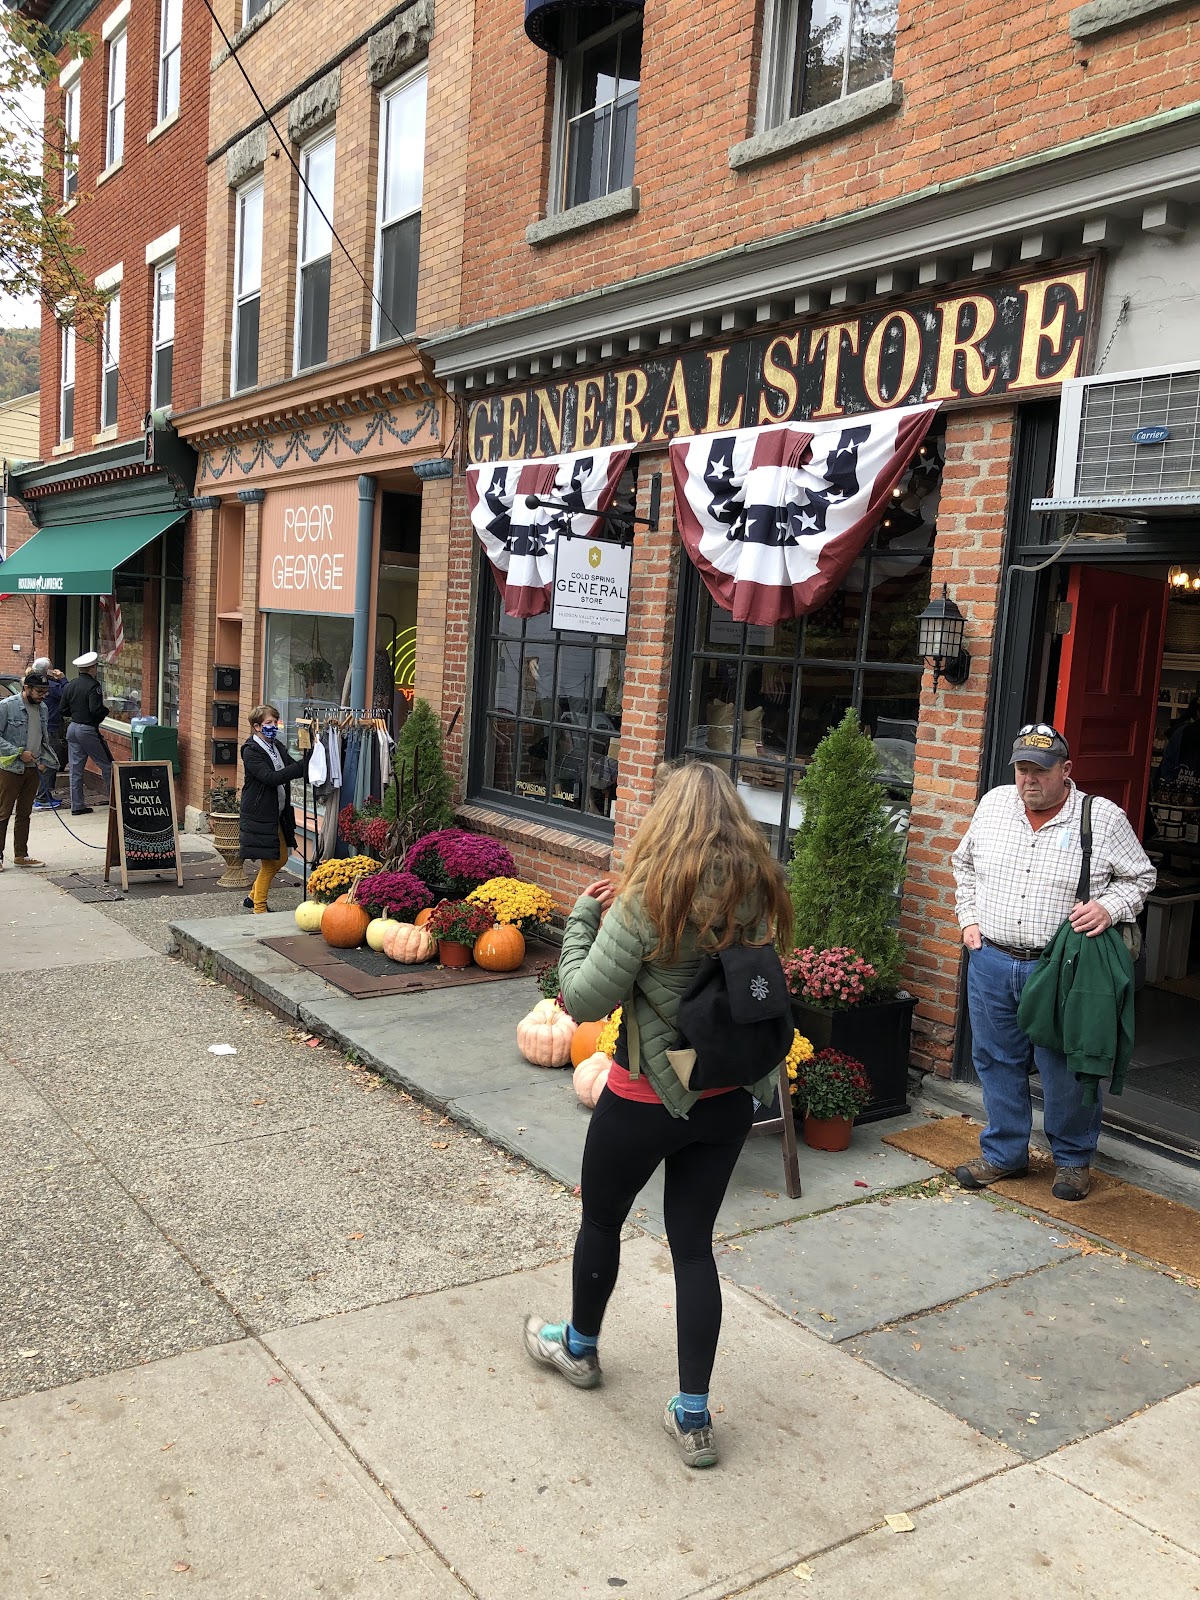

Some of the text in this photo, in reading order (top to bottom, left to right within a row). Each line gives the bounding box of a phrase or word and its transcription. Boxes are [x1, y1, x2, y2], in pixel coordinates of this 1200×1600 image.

[467, 270, 1088, 465] GENERAL STORE
[1136, 430, 1165, 440] Carrier
[283, 504, 334, 543] POOR
[271, 553, 345, 590] GEORGE
[570, 572, 616, 584] COLD SPRING
[556, 579, 627, 599] GENERAL
[580, 596, 603, 605] STORE
[129, 778, 160, 790] FINALLY
[516, 780, 575, 802] PROVISIONS HOME
[128, 795, 161, 805] SWEATA
